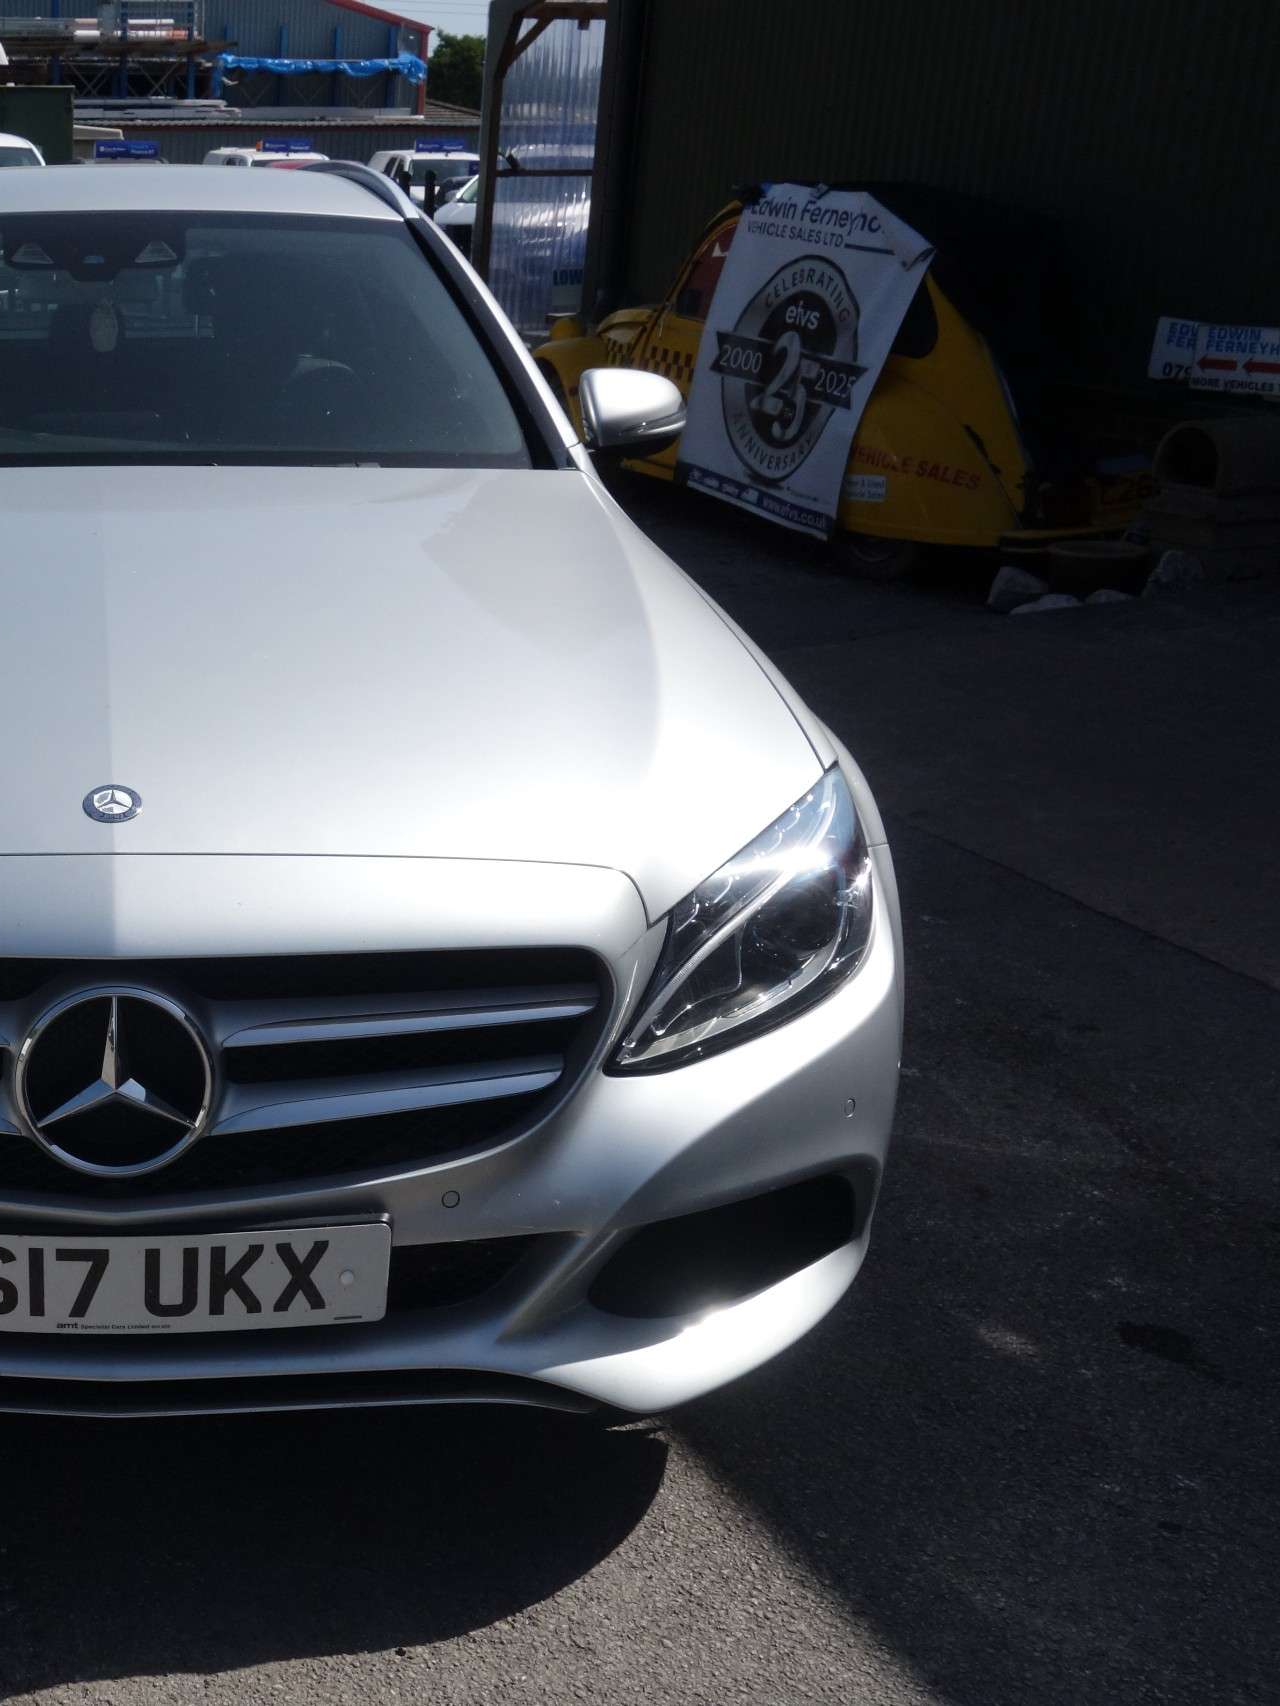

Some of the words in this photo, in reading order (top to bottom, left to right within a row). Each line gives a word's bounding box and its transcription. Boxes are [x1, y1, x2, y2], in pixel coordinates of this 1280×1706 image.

[747, 220, 788, 237] VEHICLE
[788, 226, 823, 244] SALES
[823, 231, 844, 248] LTD
[765, 267, 850, 323] CELEBRATING
[1207, 326, 1262, 340] EDWIN
[719, 344, 764, 374] 2000
[814, 368, 857, 399] 2025
[1192, 377, 1220, 388] MORE
[1224, 380, 1274, 392] VEHICLES
[731, 411, 813, 471] ANNIVERSARY
[914, 460, 982, 490] SALES
[144, 1240, 330, 1318] UKX
